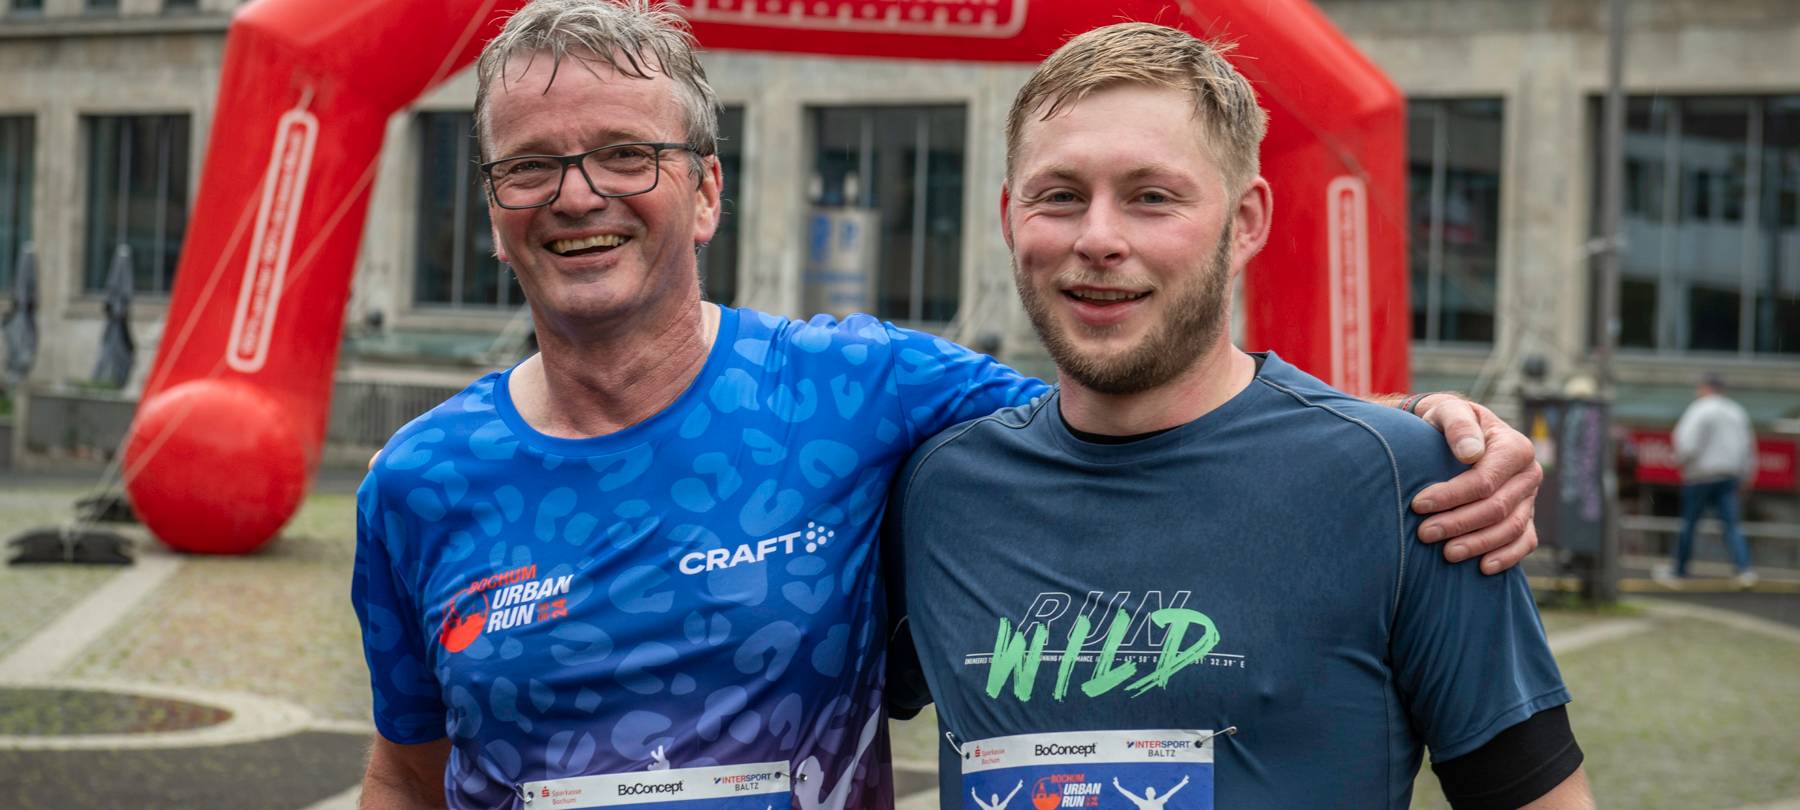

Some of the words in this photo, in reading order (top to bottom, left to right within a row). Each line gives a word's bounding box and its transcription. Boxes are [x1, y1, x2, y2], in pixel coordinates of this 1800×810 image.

[679, 531, 801, 575] CRAFT
[468, 564, 536, 595] BOCHUM
[492, 574, 574, 610] URBAN
[487, 603, 536, 634] RUN
[1015, 591, 1191, 647] RUN
[985, 608, 1220, 702] WILD
[1035, 743, 1096, 757] BoConcept
[1135, 740, 1191, 749] INTERSPORT
[1148, 749, 1176, 757] BALTZ
[722, 773, 772, 784] INTERSPORT
[618, 780, 683, 796] BoConcept
[735, 783, 760, 792] BALTZ
[1063, 783, 1102, 795] URBAN
[1061, 795, 1085, 808] RUN
